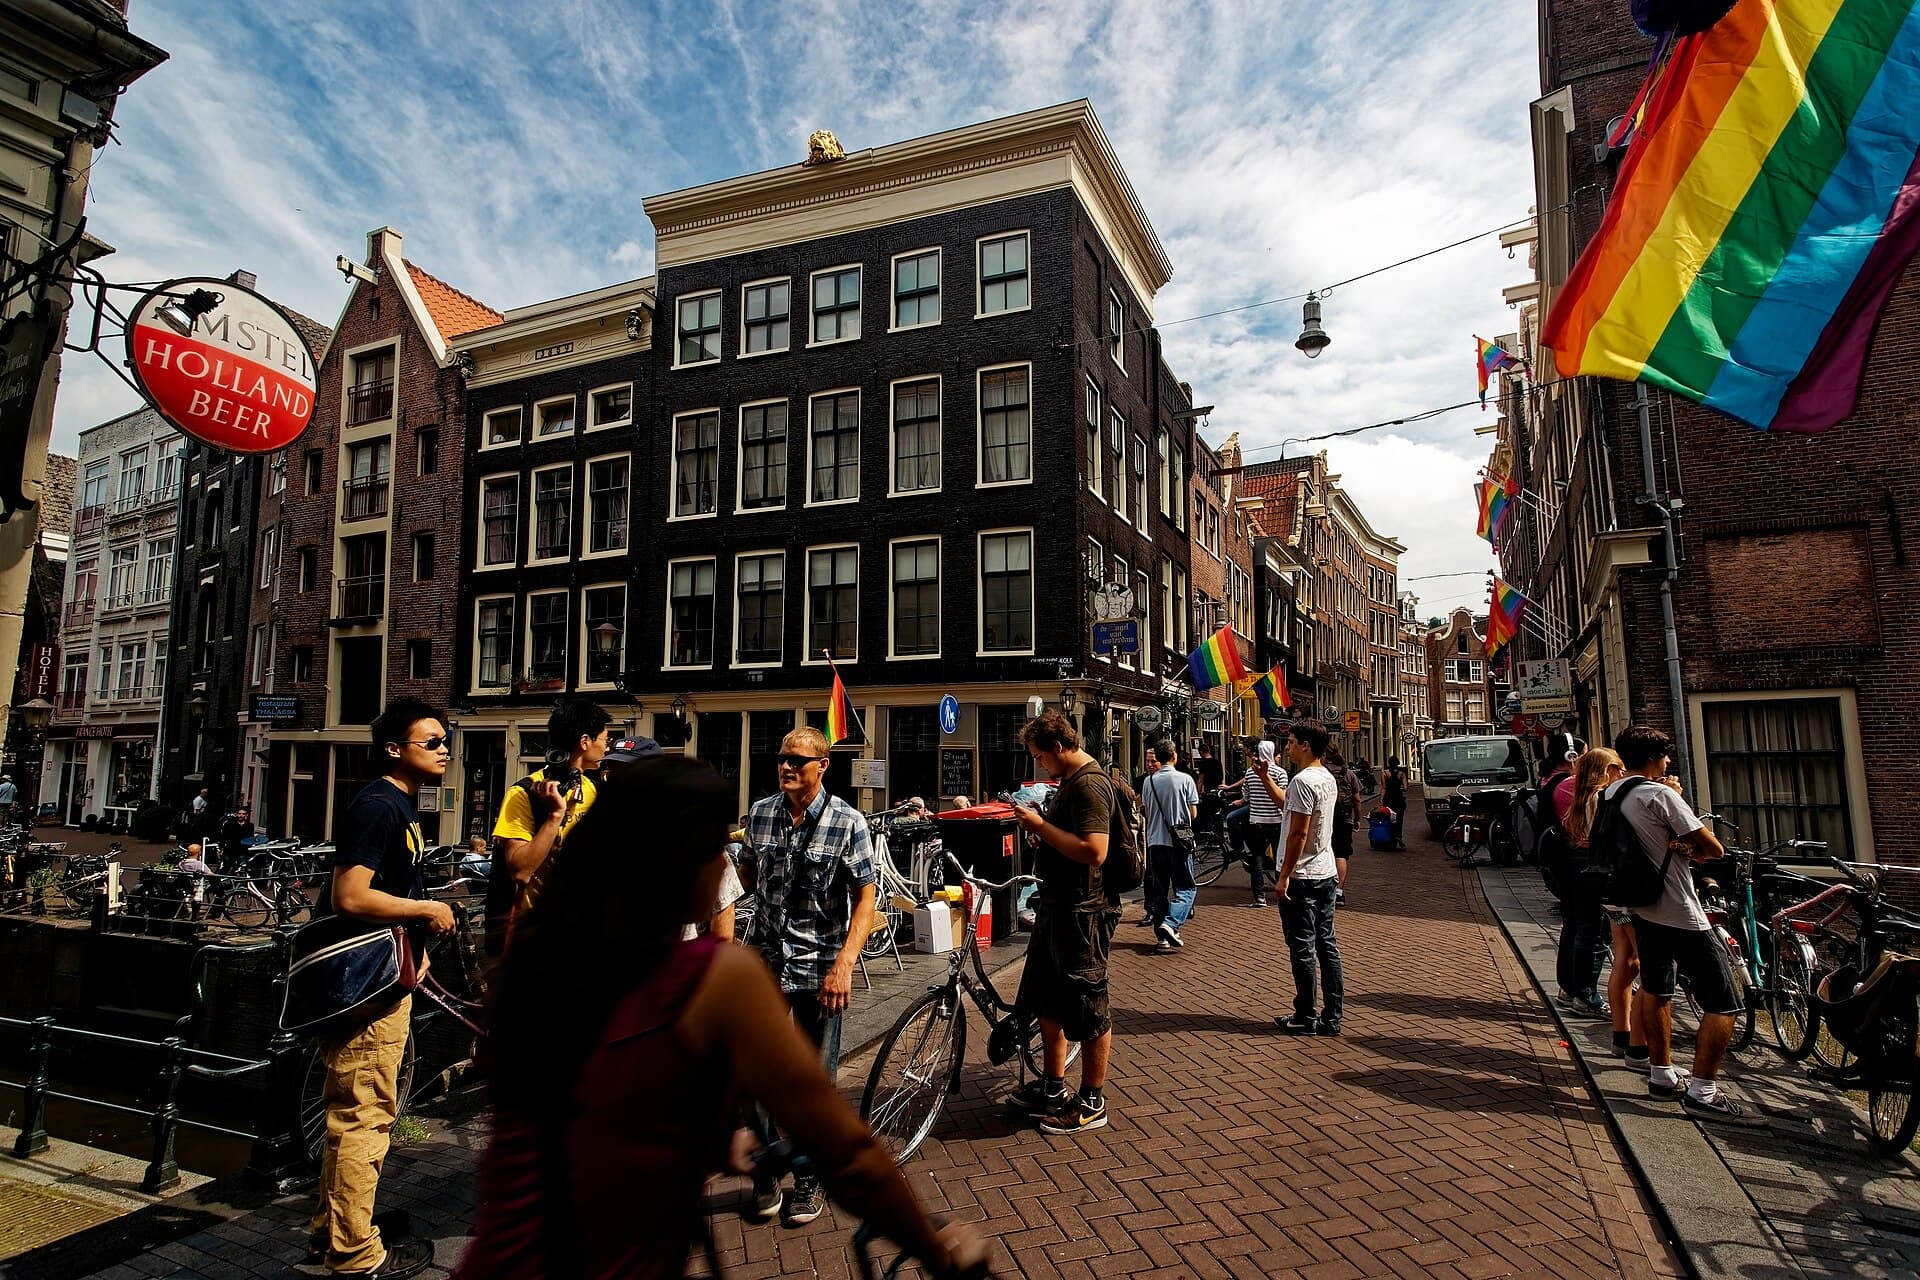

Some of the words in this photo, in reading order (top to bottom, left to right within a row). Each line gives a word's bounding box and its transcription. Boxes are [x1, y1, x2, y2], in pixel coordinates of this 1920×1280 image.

[151, 297, 312, 381] MSTEL
[143, 339, 309, 418] HOLLAND
[188, 389, 272, 440] BEER
[38, 646, 52, 695] HOTEL
[75, 727, 96, 737] FRANCE
[96, 726, 113, 737] HOTEL
